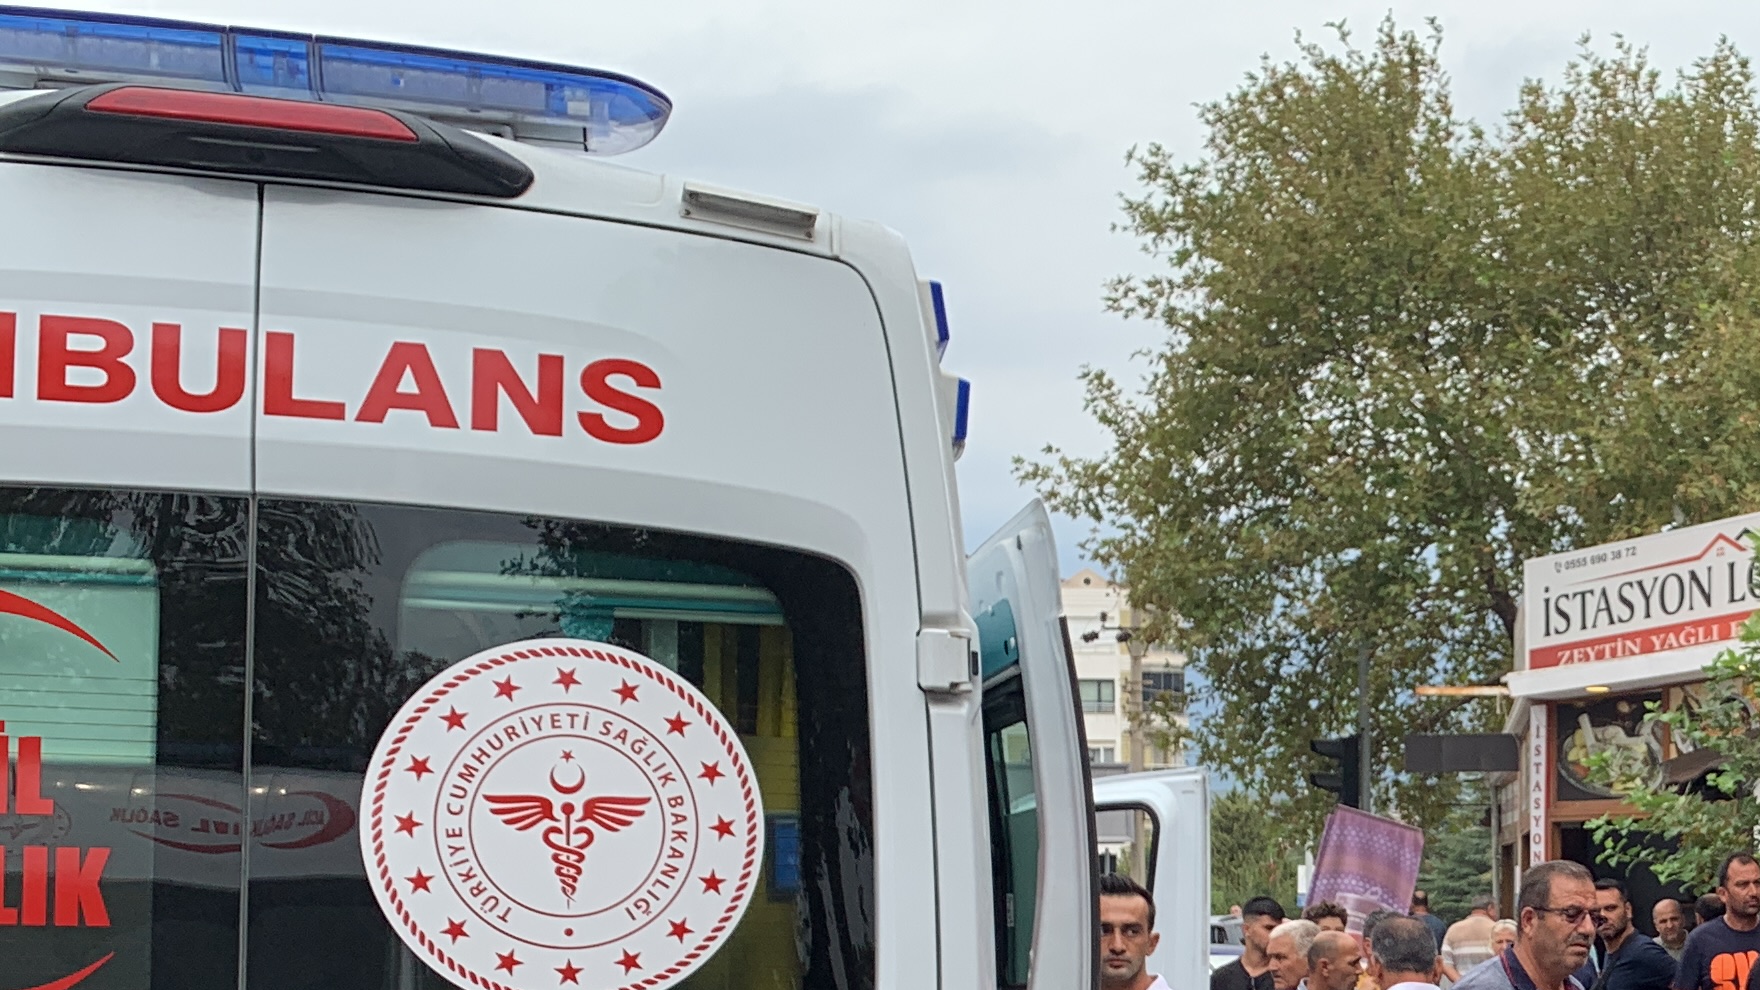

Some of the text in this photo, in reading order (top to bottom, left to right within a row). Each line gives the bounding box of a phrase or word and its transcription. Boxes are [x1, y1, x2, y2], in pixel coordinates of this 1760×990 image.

[1543, 565, 1713, 638] İSTASYON
[1557, 636, 1642, 666] ZEYTİN
[1649, 625, 1720, 651] YAĞLI
[445, 711, 688, 924] TÜRKİYE CUMHURİYETİ SAĞLIK BAKANLIĞI
